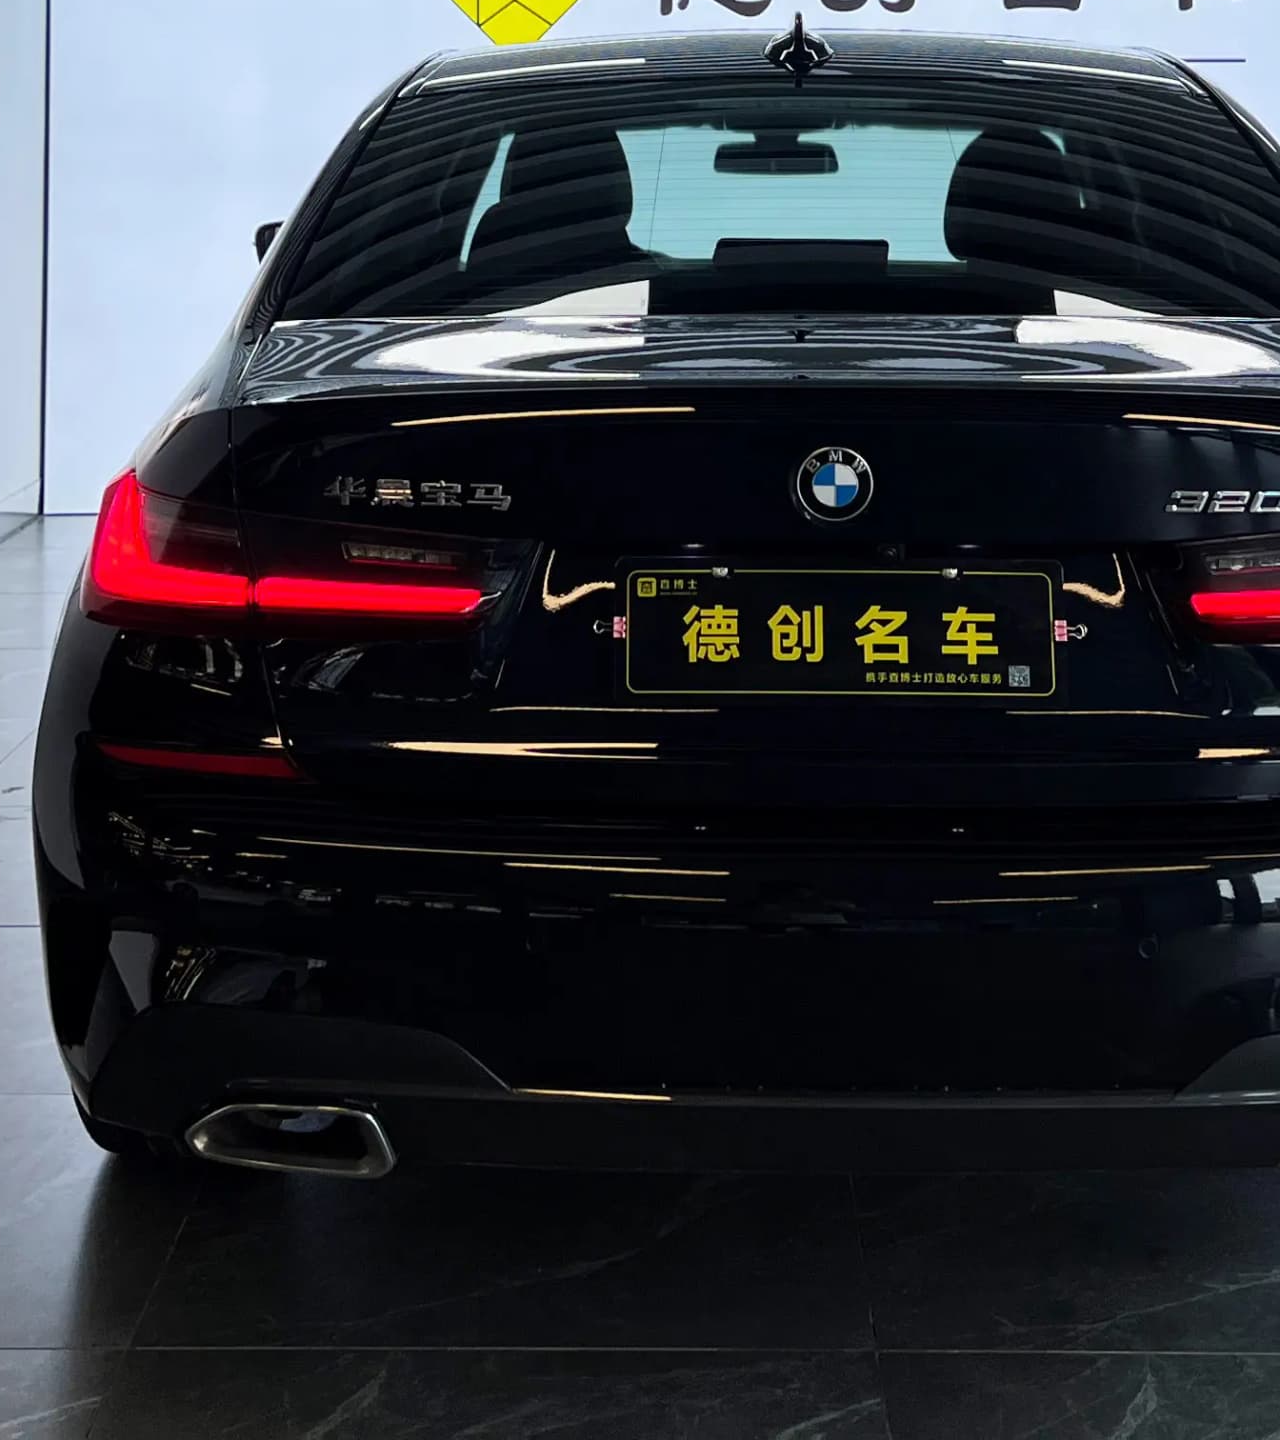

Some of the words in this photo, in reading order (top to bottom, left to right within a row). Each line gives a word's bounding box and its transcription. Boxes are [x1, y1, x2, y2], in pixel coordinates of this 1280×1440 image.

[806, 450, 866, 474] BMW
[682, 605, 999, 665] 德创名车
